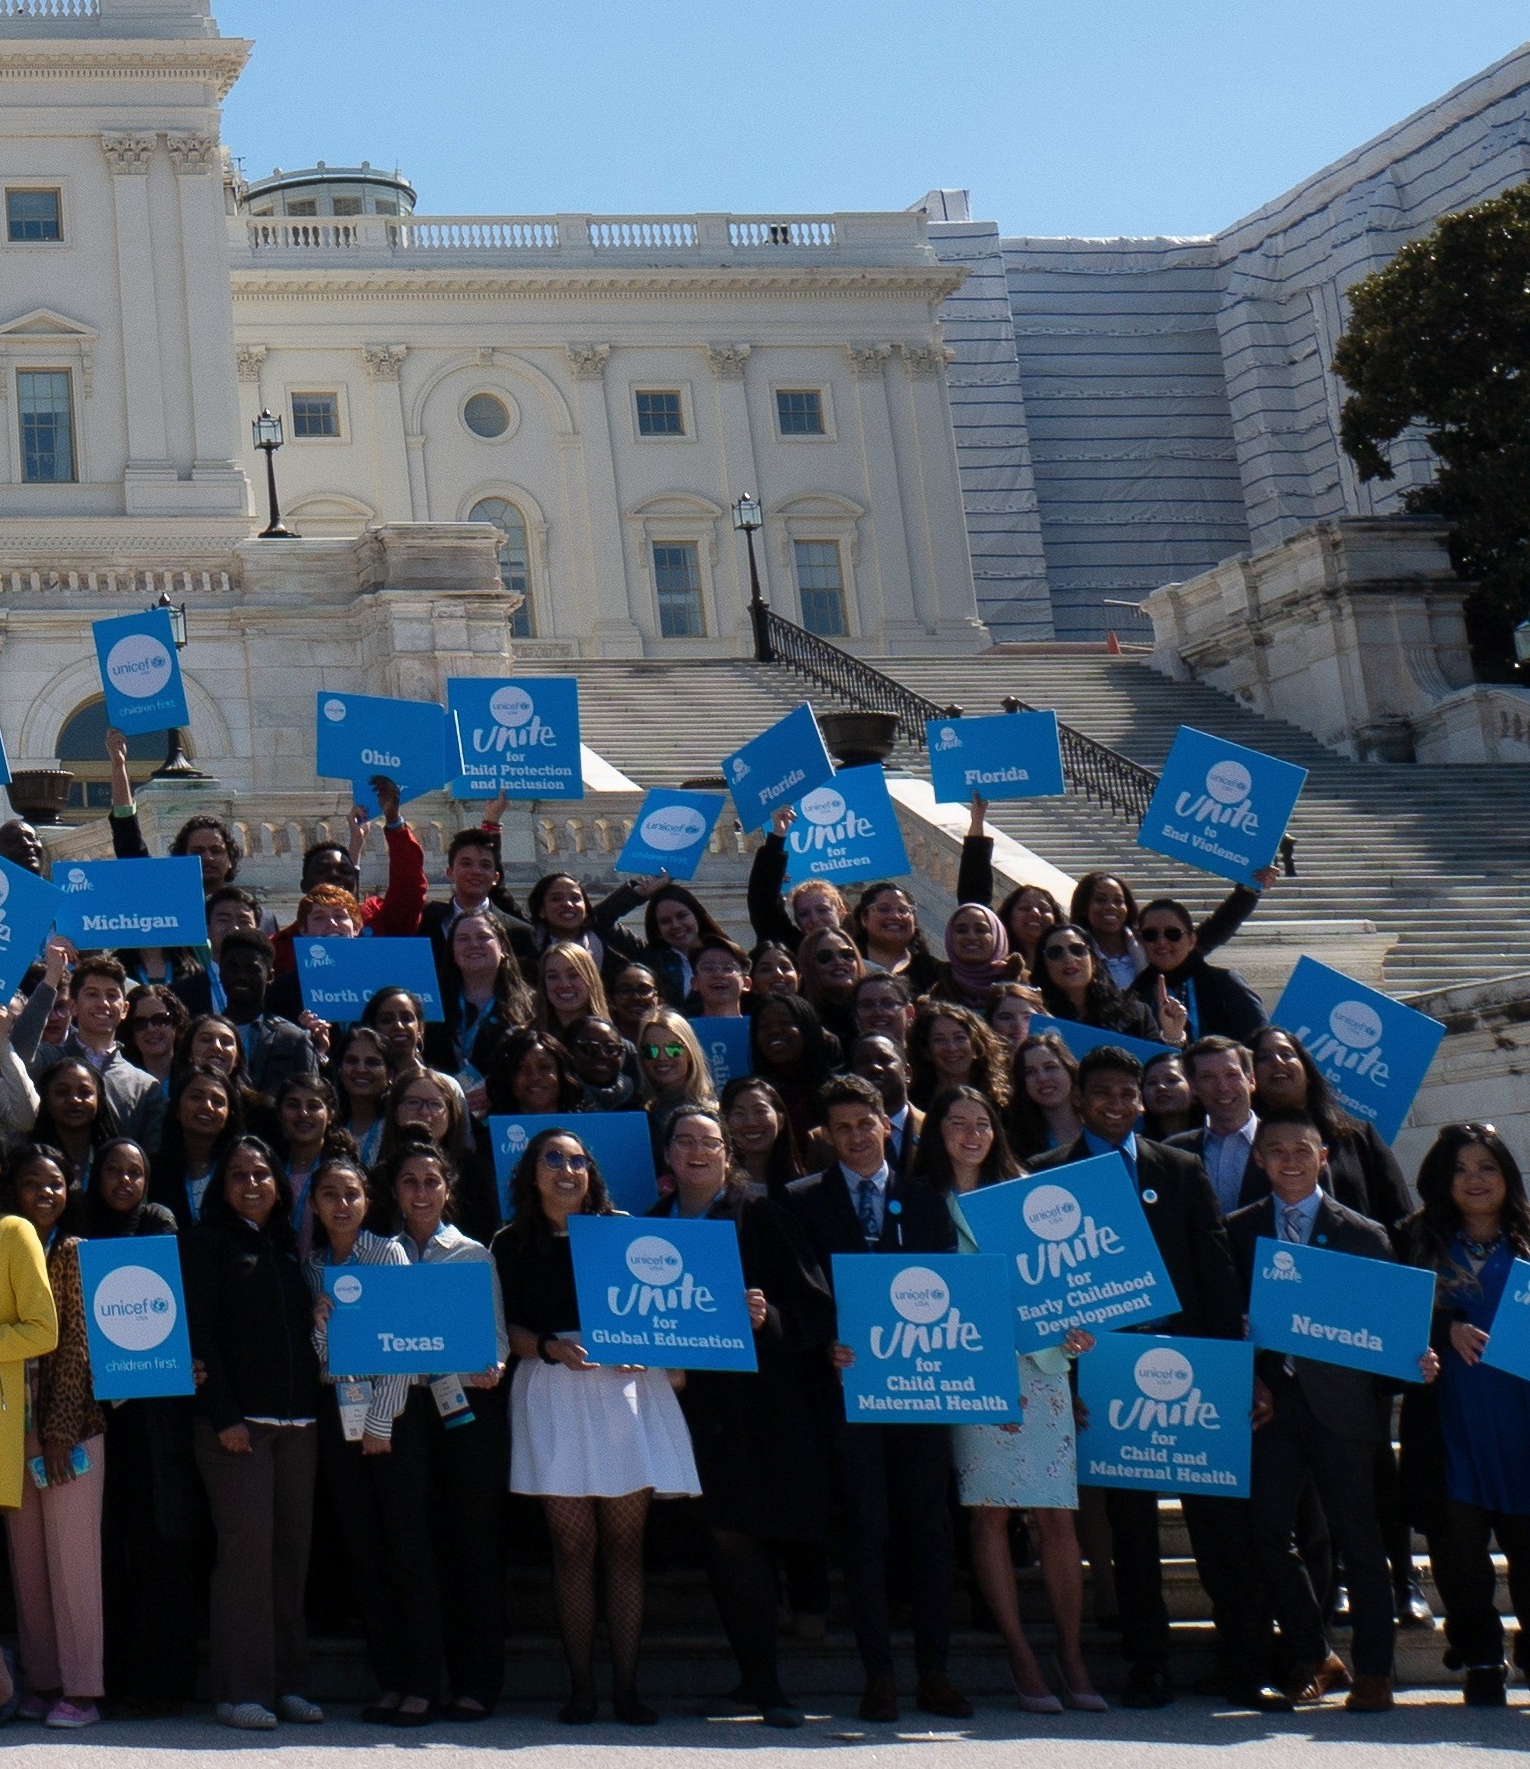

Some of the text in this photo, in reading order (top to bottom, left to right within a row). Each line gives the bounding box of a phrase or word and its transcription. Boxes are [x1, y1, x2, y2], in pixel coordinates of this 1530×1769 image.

[113, 657, 149, 675] unicef
[492, 702, 520, 711] unicef
[361, 748, 401, 768] Ohio
[506, 750, 525, 762] for
[501, 764, 572, 776] Protection
[965, 766, 1029, 785] Florida
[471, 778, 565, 790] and Inclusion
[759, 768, 806, 806] Florida
[1204, 826, 1217, 838] to
[827, 847, 846, 858] for
[1162, 824, 1249, 866] End Violence
[810, 856, 871, 874] Children
[82, 914, 179, 932] Michigan
[311, 988, 359, 1002] North
[1325, 1067, 1341, 1083] to
[631, 1254, 664, 1266] unicef
[1066, 1272, 1092, 1287] for
[895, 1288, 930, 1300] unicef
[1017, 1271, 1157, 1322] Early Childhood
[101, 1298, 149, 1317] unicef
[1035, 1293, 1152, 1336] Development
[653, 1315, 678, 1330] for
[592, 1329, 745, 1350] Global Education
[1291, 1314, 1383, 1352] Nevada
[377, 1332, 445, 1352] Texas
[105, 1358, 152, 1373] children
[915, 1357, 943, 1372] for
[886, 1376, 975, 1392] Child and
[857, 1394, 1009, 1411] Maternal Health
[1151, 1430, 1177, 1446] for
[1119, 1446, 1208, 1466] Child and
[1090, 1460, 1238, 1486] Maternal Health
